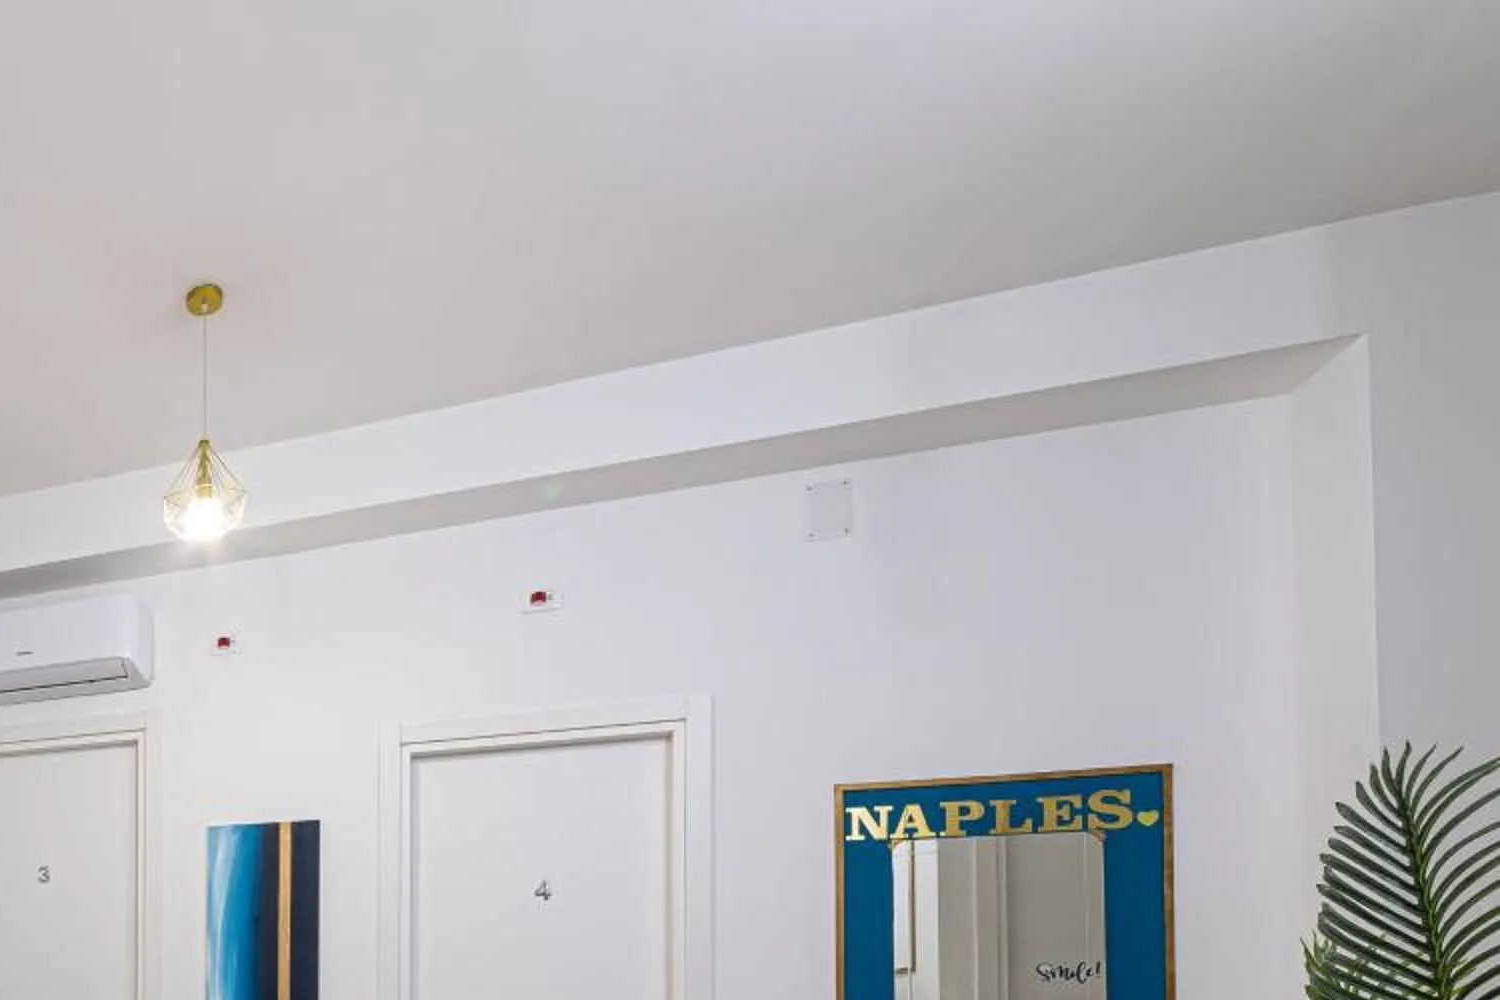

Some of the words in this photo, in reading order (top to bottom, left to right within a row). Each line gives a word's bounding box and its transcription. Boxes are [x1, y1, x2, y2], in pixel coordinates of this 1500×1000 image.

[844, 788, 1135, 842] NAPLES
[37, 865, 51, 884] 3
[534, 879, 552, 901] 4
